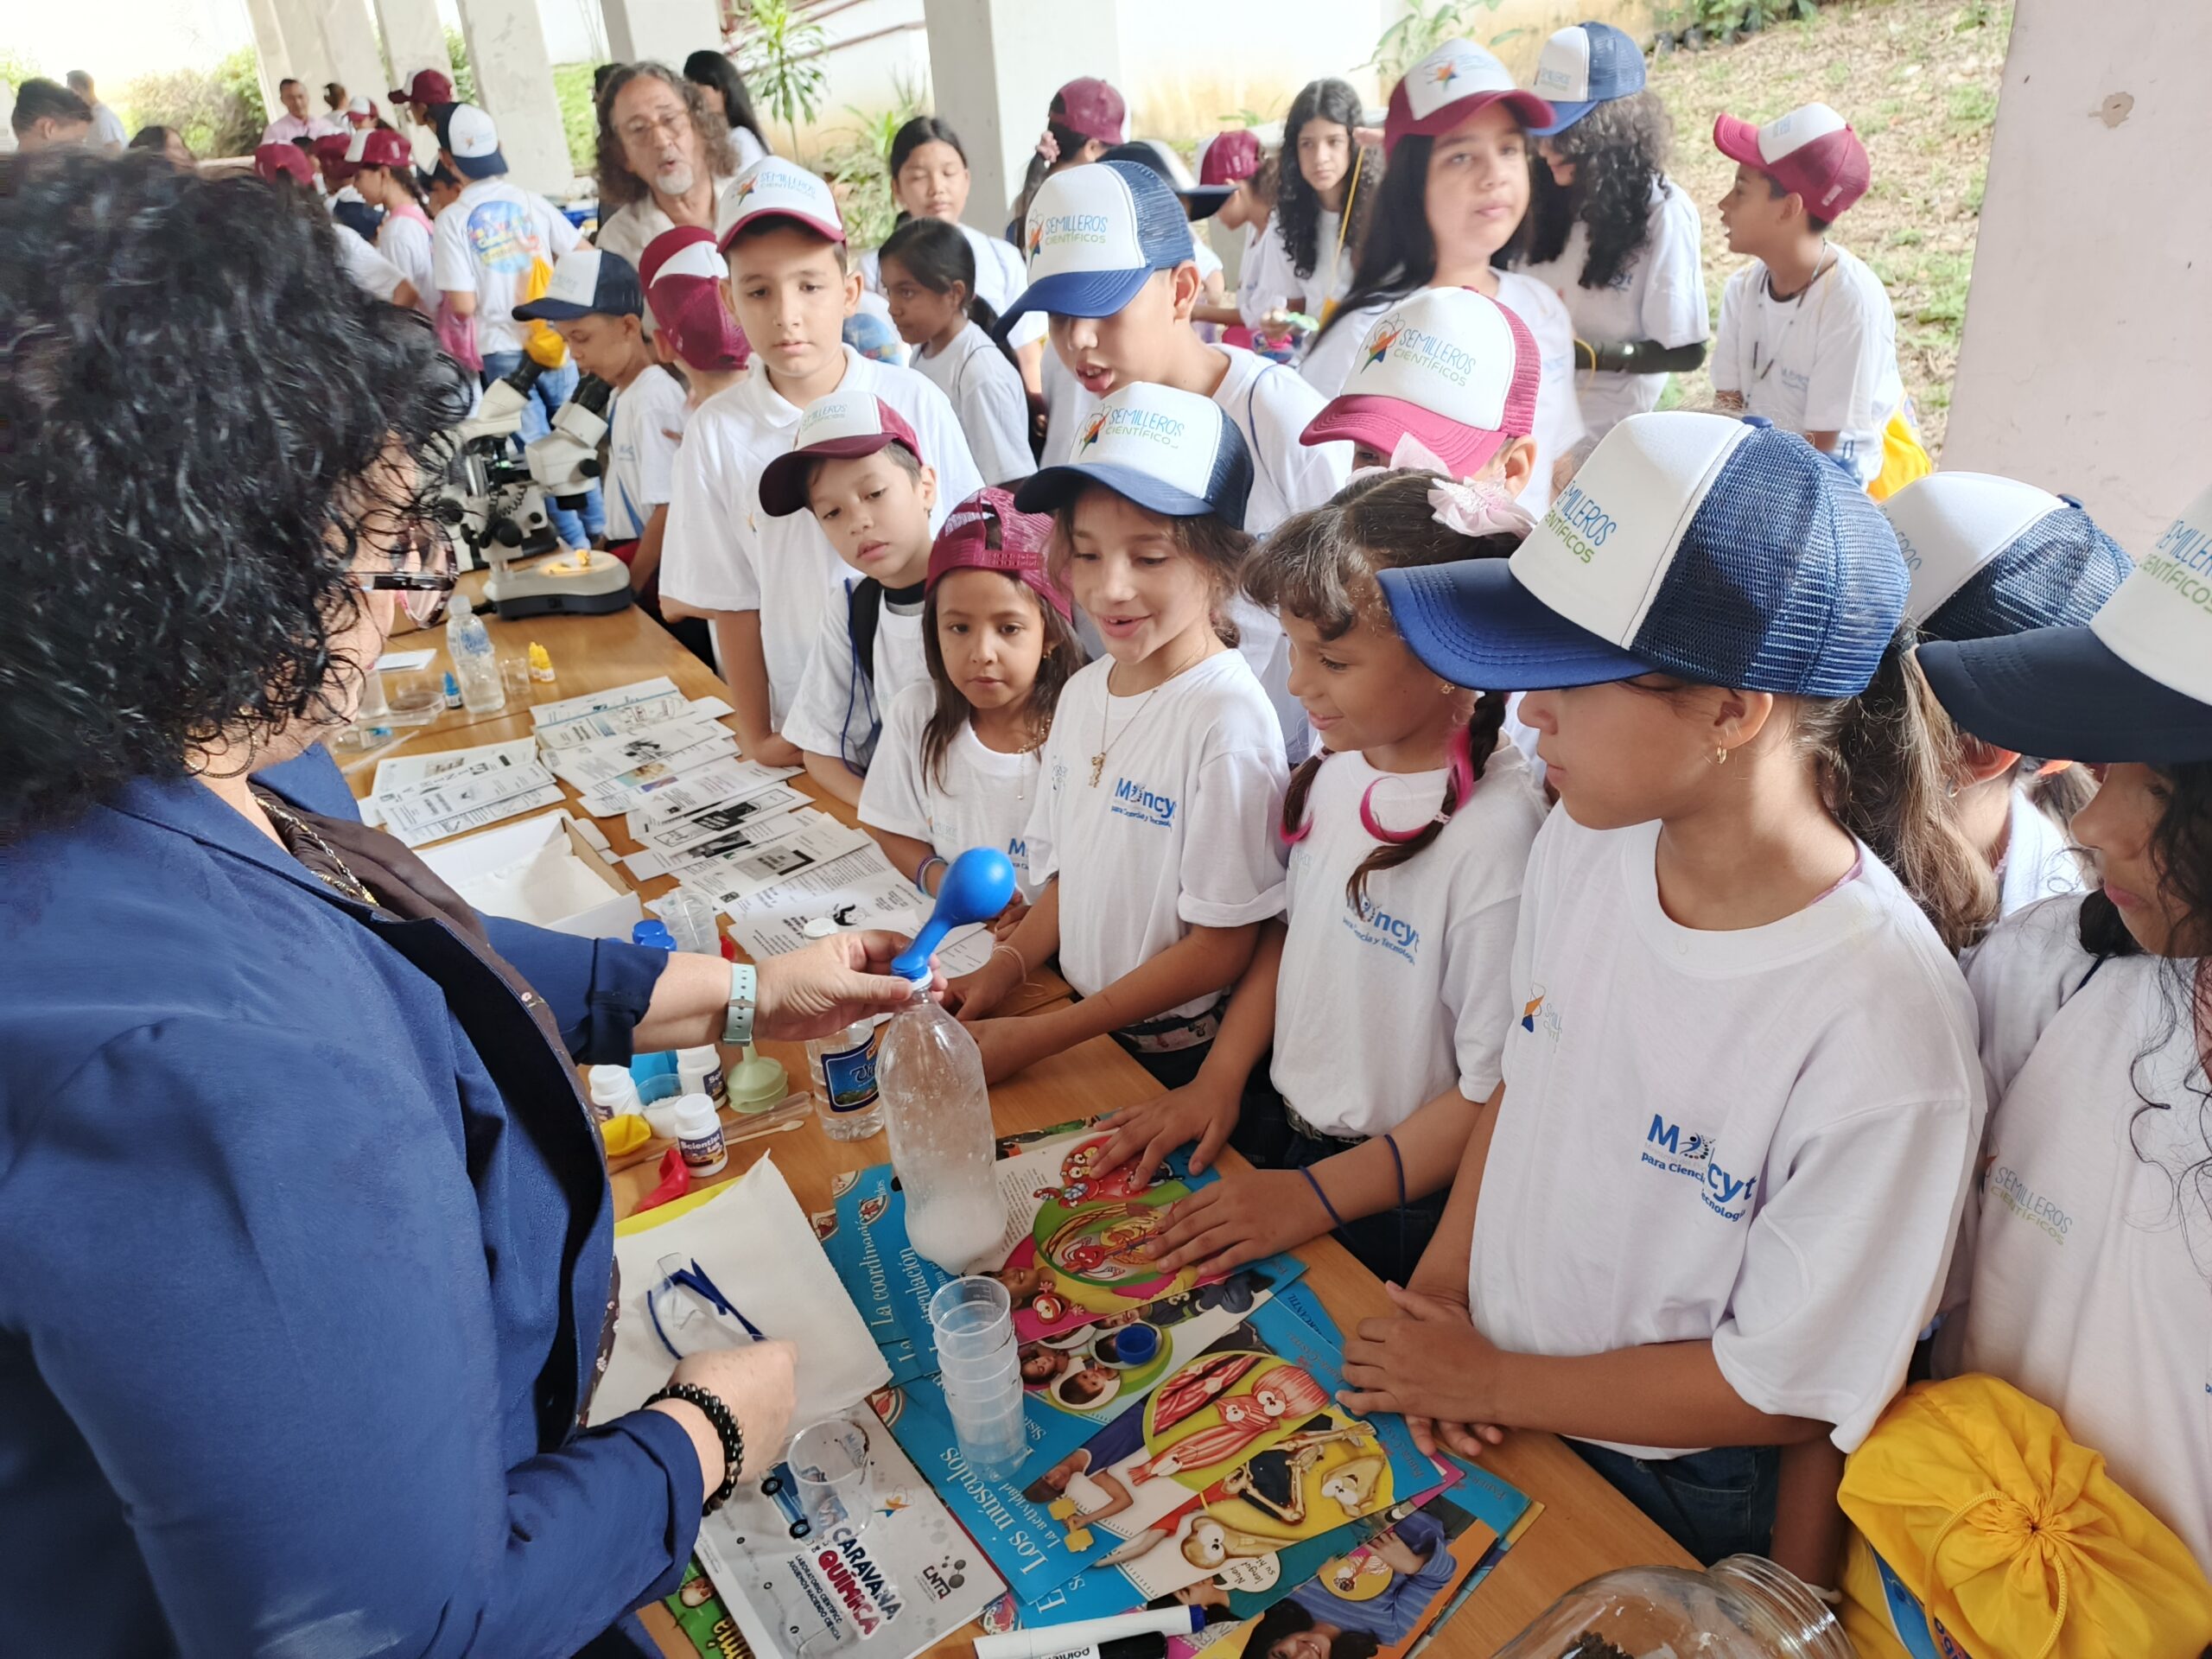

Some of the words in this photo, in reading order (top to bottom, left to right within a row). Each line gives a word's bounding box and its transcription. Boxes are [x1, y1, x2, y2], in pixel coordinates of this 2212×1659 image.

[1045, 232, 1106, 245] CIENTÍFICOS
[1046, 214, 1108, 235] SEMILLEROS
[1393, 347, 1467, 387] CIENTÍFICOS
[1400, 328, 1476, 375] SEMILLEROS
[1109, 408, 1185, 436] SEMILLEROS
[1556, 480, 1617, 546] EMILLEROS
[680, 1133, 721, 1150] Scientist
[1641, 1152, 1666, 1171] para
[1995, 1166, 2073, 1234] SEMILLEROS
[898, 1246, 933, 1325] circulación
[871, 1304, 893, 1327] La
[940, 1446, 1016, 1531] músculos
[998, 1482, 1048, 1531] actividad
[1007, 1530, 1048, 1575] Los
[1044, 1529, 1062, 1548] La
[795, 1554, 823, 1595] LABORATORIO
[820, 1592, 843, 1624] CIENTÍFICO
[818, 1550, 880, 1636] QUÍMICA
[832, 1527, 902, 1620] CARAVANA
[787, 1560, 810, 1591] JUGUEMOS
[805, 1588, 828, 1619] HACIENDO
[823, 1614, 842, 1642] CIENCIA
